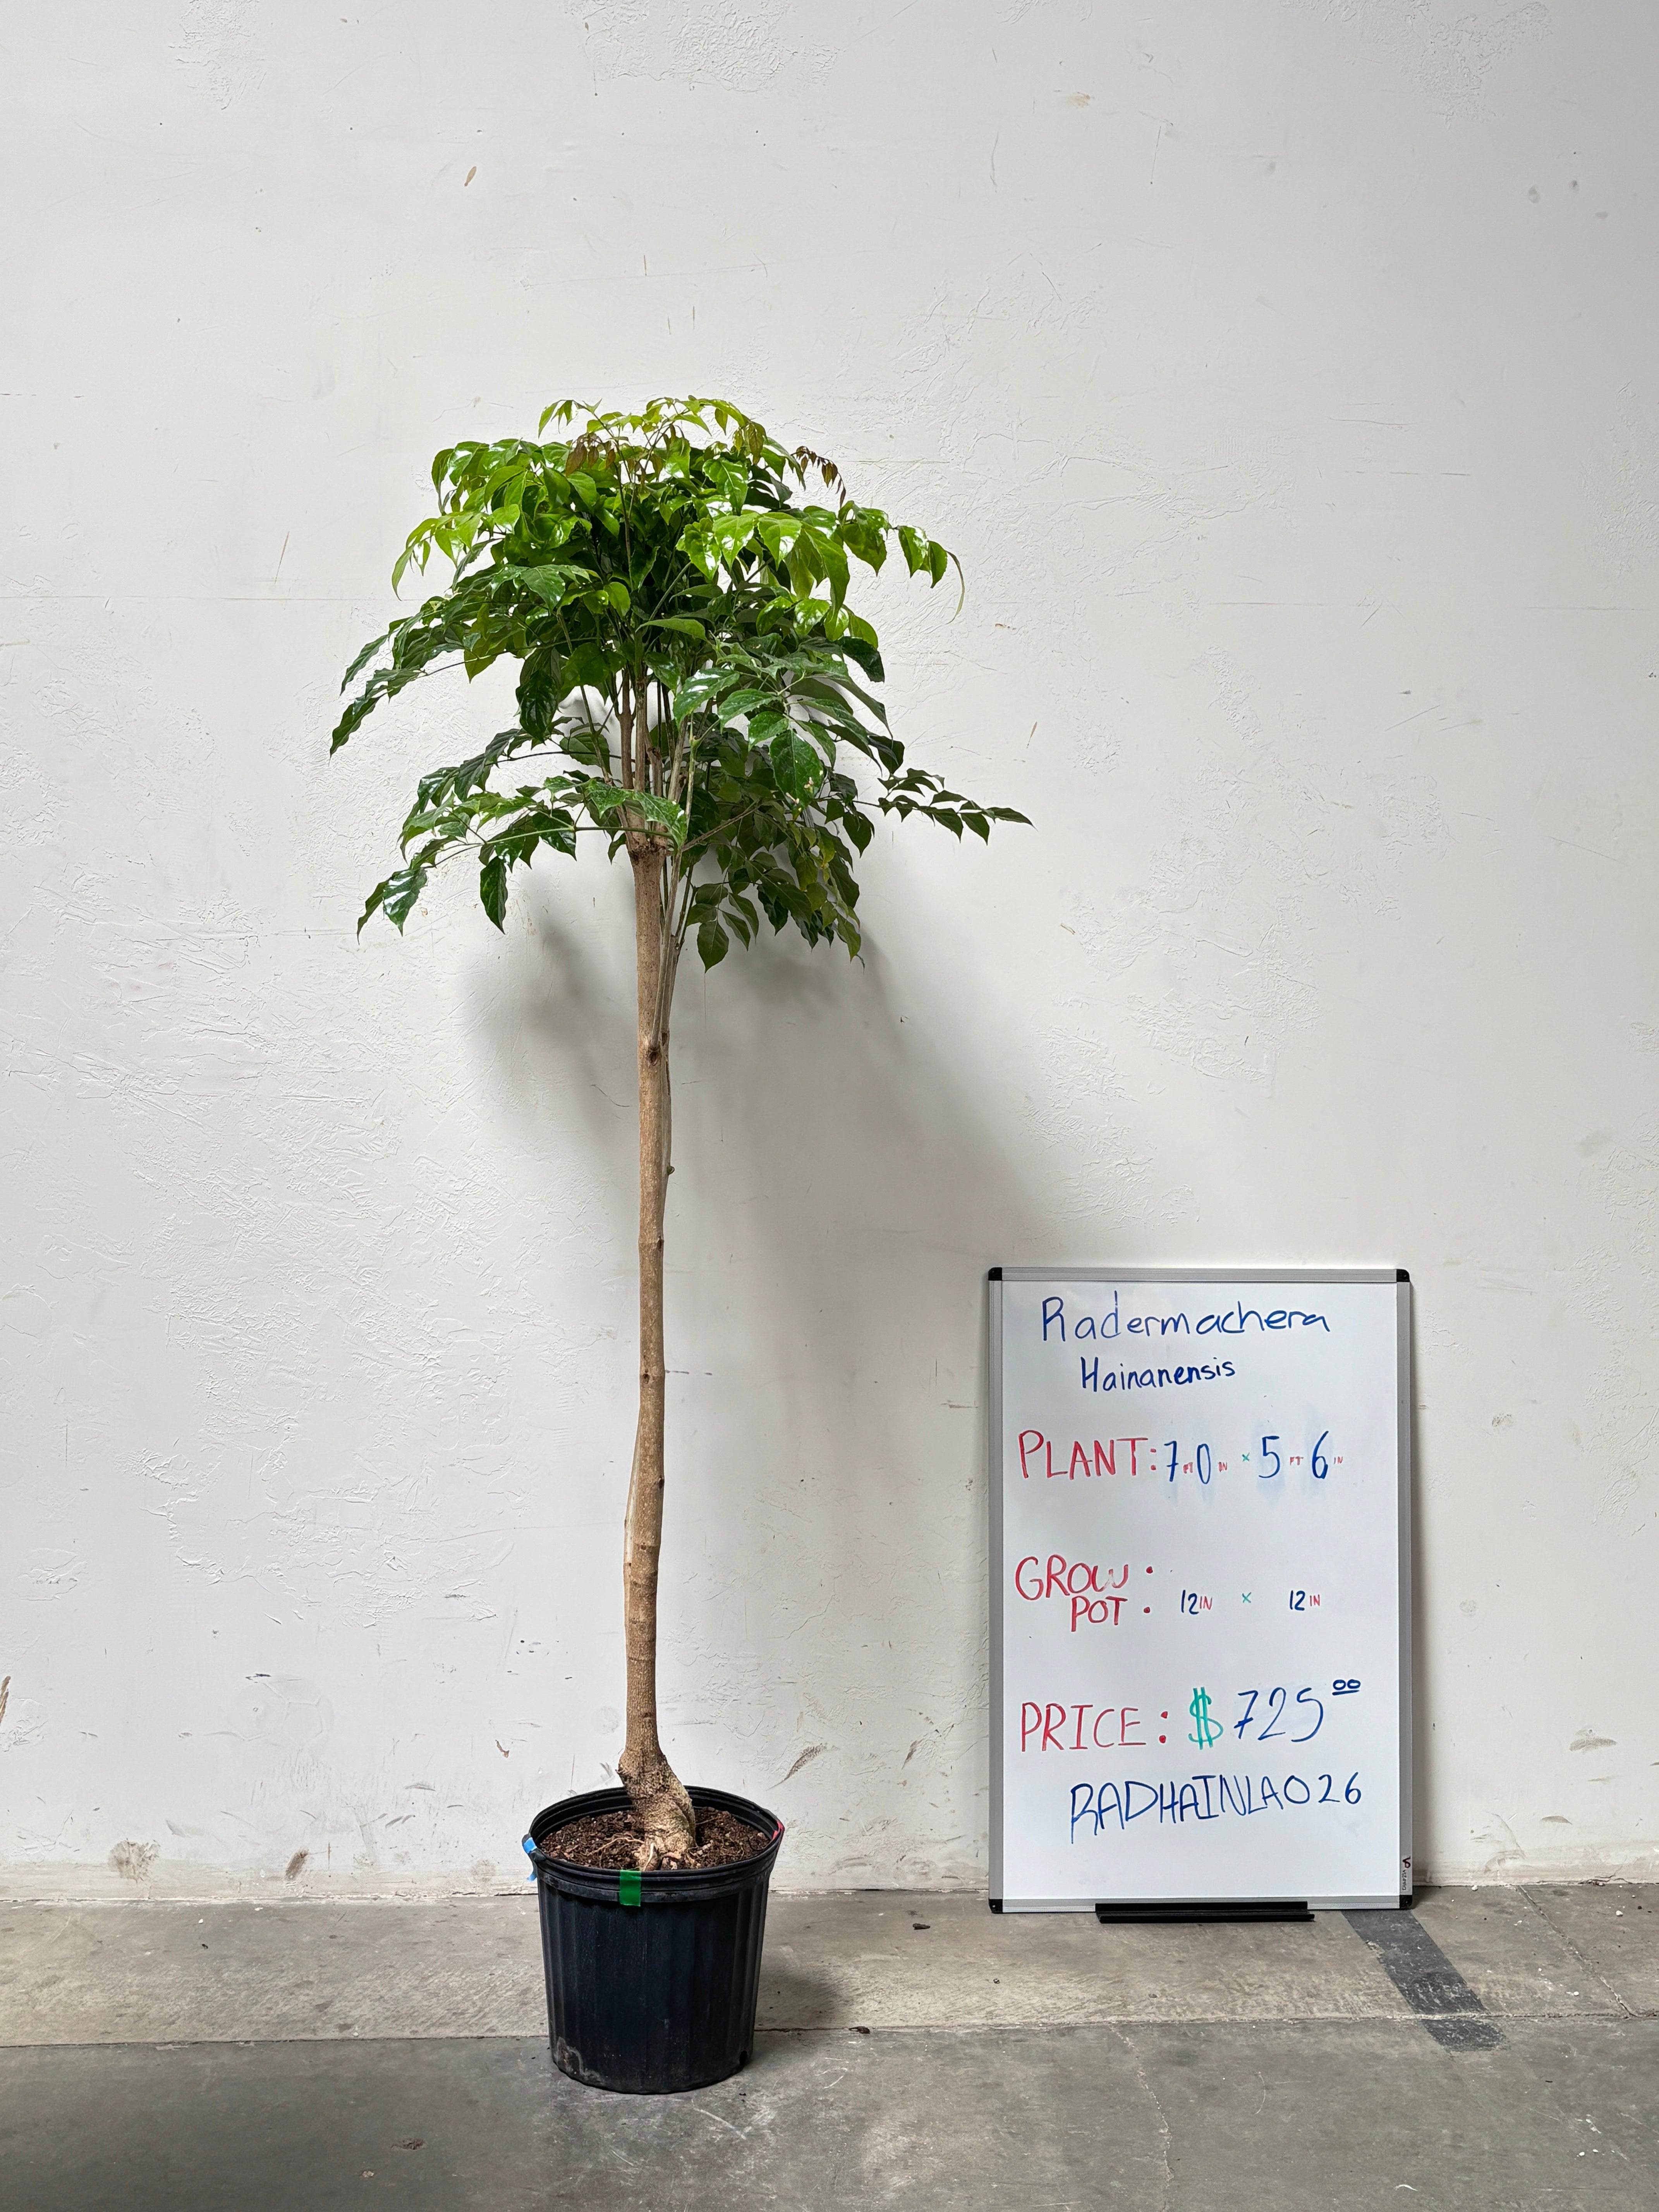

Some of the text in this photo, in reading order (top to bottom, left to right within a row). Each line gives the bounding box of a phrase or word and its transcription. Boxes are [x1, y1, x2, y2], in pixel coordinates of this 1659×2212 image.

[1042, 1290, 1331, 1341] Radermachera
[1080, 1357, 1235, 1392] Hainanensis
[1018, 1430, 1157, 1479] PLANT:
[1258, 1435, 1281, 1479] 5
[1310, 1431, 1329, 1480] 6
